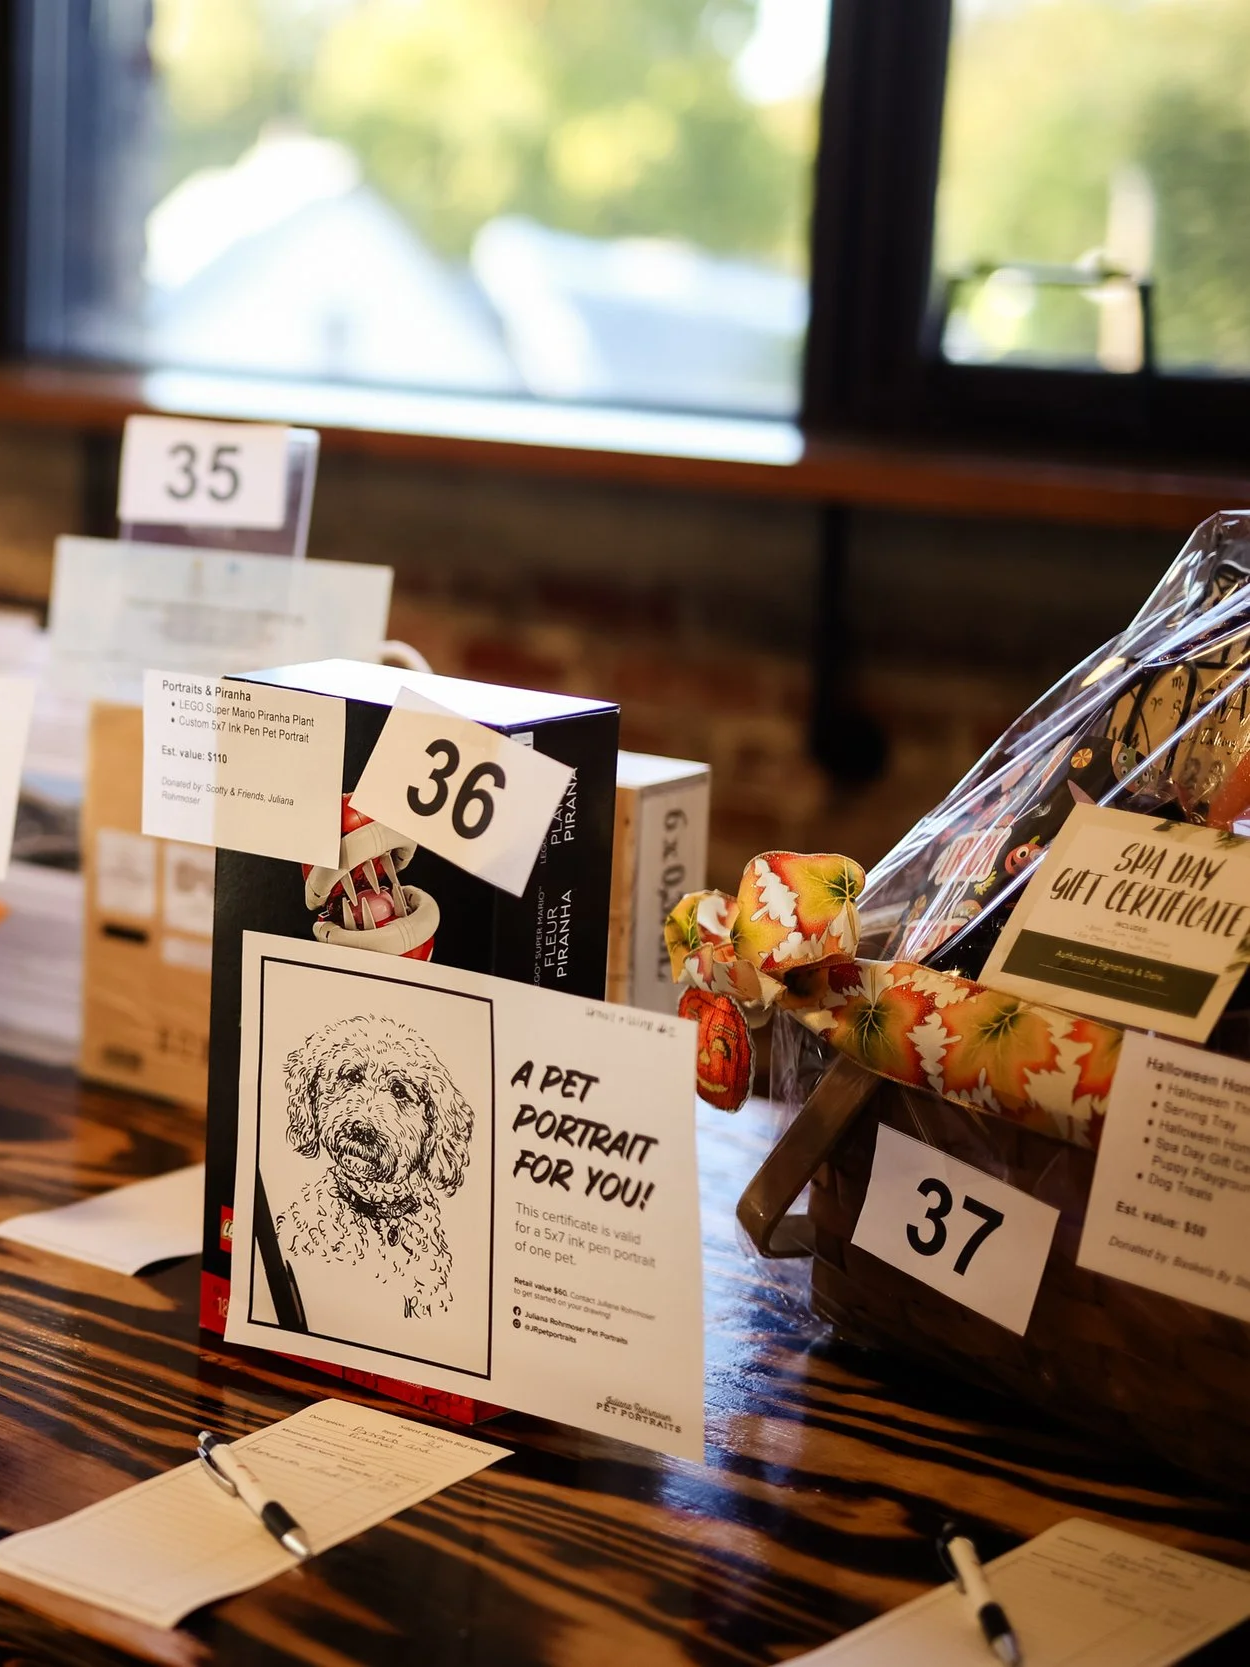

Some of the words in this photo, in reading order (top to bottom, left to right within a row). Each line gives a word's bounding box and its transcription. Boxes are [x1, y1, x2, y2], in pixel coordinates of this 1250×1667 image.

[165, 444, 243, 502] 35
[162, 680, 203, 696] Portraits
[205, 685, 213, 696] &
[215, 686, 252, 702] Piranha
[179, 699, 204, 713] LEGO
[206, 703, 230, 718] Super
[232, 706, 256, 720] Mario
[257, 709, 290, 725] Piranha
[292, 714, 315, 728] Plant
[179, 716, 210, 730] Custom
[211, 720, 226, 732] 5x7
[228, 722, 241, 734] Ink
[243, 724, 260, 737] Pen
[262, 727, 277, 739] Pet
[278, 729, 310, 744] Portrait
[161, 745, 177, 756] Est.
[179, 748, 205, 761] value:
[207, 751, 228, 764] $110
[161, 776, 191, 790] Donated
[205, 783, 229, 797] Scotty
[229, 787, 236, 797] &
[237, 788, 266, 803] Friends,
[268, 793, 295, 807] Juliana
[406, 738, 506, 840] 36
[1114, 843, 1168, 879] SPA
[1167, 852, 1228, 891] DAY
[1050, 868, 1109, 905] GIFT
[1105, 879, 1250, 938] CERTIFICATE
[545, 906, 558, 967] FLEUR
[556, 889, 572, 977] PIRANHA
[511, 1060, 534, 1089] A
[539, 1065, 600, 1103] PET
[1146, 1057, 1219, 1087] Halloween
[1167, 1083, 1231, 1111] Halloween
[1158, 1119, 1221, 1147] Halloween
[1163, 1101, 1209, 1127] Serving
[1212, 1114, 1238, 1134] Tray
[512, 1104, 659, 1165] PORTRAIT
[1156, 1137, 1180, 1154] Spa
[1182, 1145, 1207, 1164] Day
[513, 1149, 574, 1192] FOR
[584, 1166, 655, 1212] YOU!
[1151, 1155, 1190, 1178] Puppy
[1148, 1172, 1173, 1193] Dog
[515, 1201, 539, 1219] This
[542, 1210, 598, 1234] certificate
[600, 1223, 611, 1237] is
[613, 1228, 642, 1245] valid
[906, 1177, 1005, 1276] 37
[514, 1240, 527, 1252] of
[529, 1244, 552, 1259] one
[554, 1250, 577, 1267] pet.
[515, 1220, 531, 1234] for
[533, 1227, 541, 1238] a
[544, 1227, 565, 1243] 5x7
[568, 1234, 585, 1249] ink
[588, 1241, 611, 1256] pen
[613, 1247, 656, 1268] portrait
[1108, 1235, 1155, 1258] Donated
[513, 1287, 521, 1296] to
[522, 1290, 533, 1299] get
[534, 1293, 556, 1306] started
[557, 1298, 567, 1307] on
[567, 1301, 583, 1312] your
[514, 1277, 533, 1288] Retail
[534, 1282, 552, 1293] value
[524, 1311, 548, 1323] Juliana
[549, 1317, 586, 1333] Rohrmoser
[587, 1327, 599, 1338] Pet
[599, 1331, 628, 1345] Portraits
[524, 1324, 577, 1344] @JRpetportraits
[596, 1402, 617, 1414] PET
[620, 1409, 682, 1434] PORTRAITS
